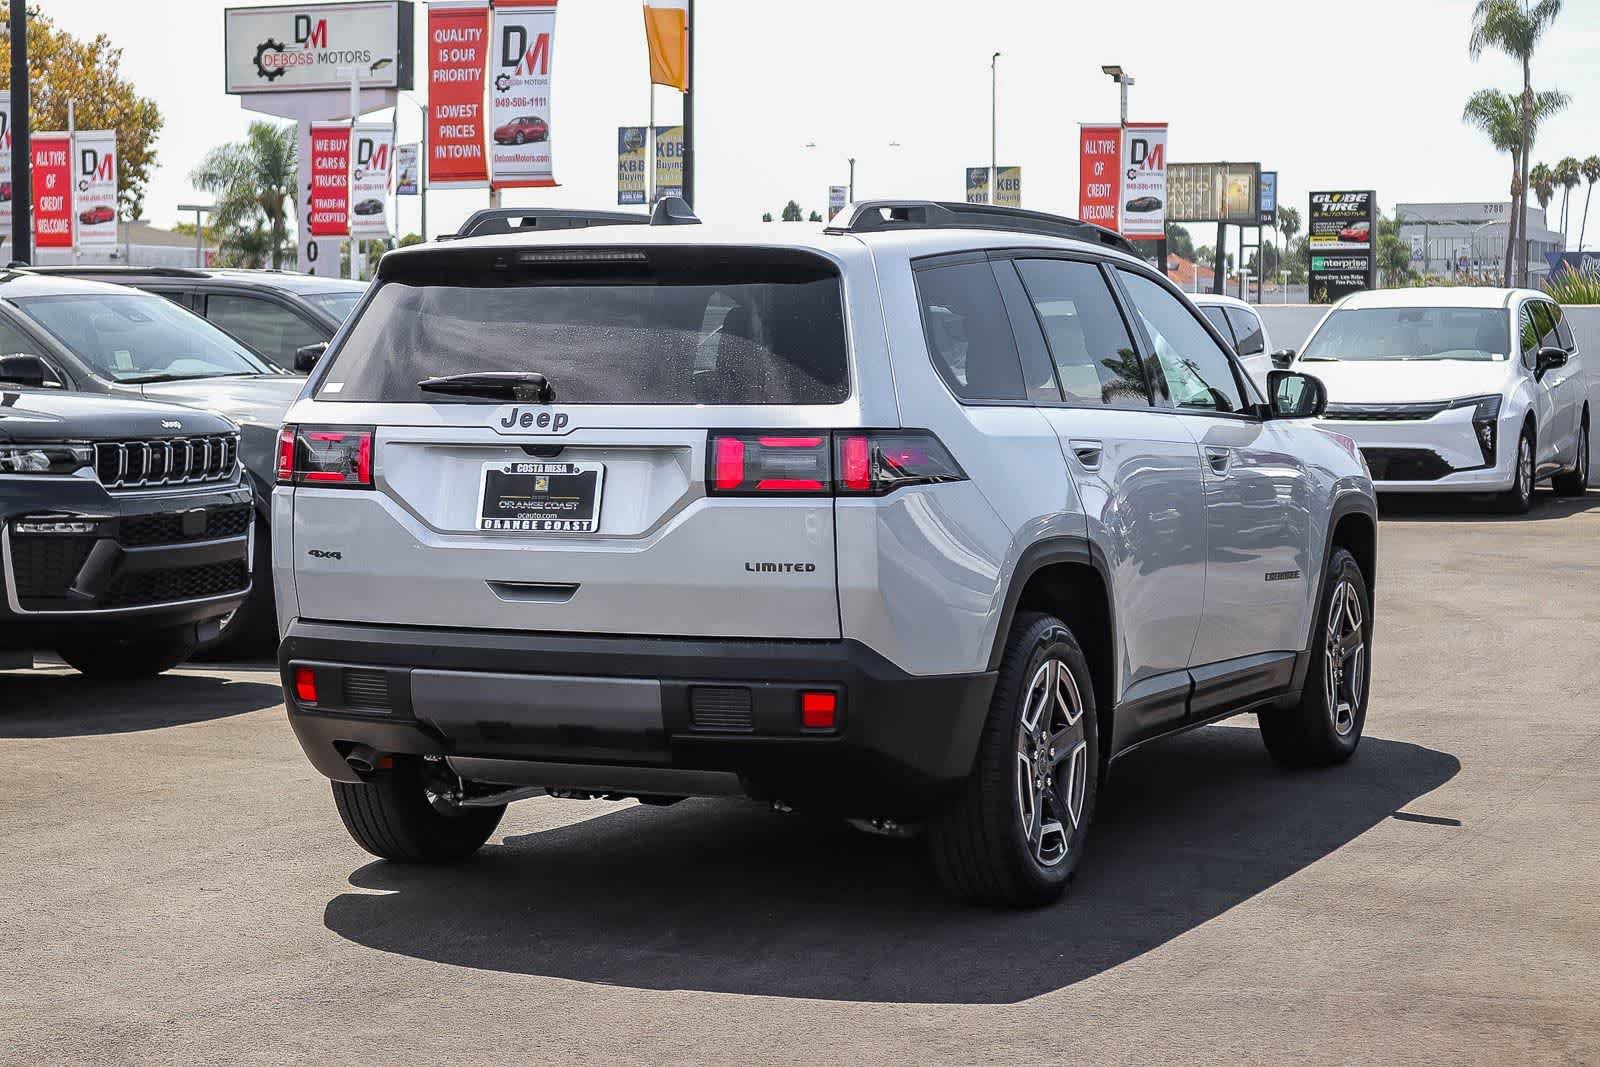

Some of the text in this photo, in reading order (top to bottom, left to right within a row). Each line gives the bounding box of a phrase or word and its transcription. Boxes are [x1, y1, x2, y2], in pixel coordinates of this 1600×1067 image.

[434, 28, 482, 44] QUALITY
[440, 48, 476, 62] IS OUR
[502, 25, 550, 76] DM
[264, 50, 370, 66] DEBOSS MOTORS
[434, 68, 482, 82] PRIORITY
[436, 104, 478, 118] LOWEST
[440, 124, 476, 138] PRICES
[315, 140, 348, 152] WE BUY
[435, 144, 481, 158] IN TOWN
[1085, 140, 1116, 154] ALL TYPE
[36, 151, 66, 166] ALL TYPE
[1131, 138, 1164, 170] DM
[316, 157, 346, 170] CARS &
[1094, 162, 1104, 176] OF
[46, 174, 56, 188] OF
[316, 175, 346, 187] TRUCKS
[1088, 184, 1112, 198] CREDIT
[40, 196, 64, 212] CREDIT
[315, 198, 346, 208] TRADE-IN
[1312, 194, 1368, 203] GLOBE
[1083, 204, 1114, 220] WELCOME
[1322, 203, 1360, 212] TIRE
[314, 212, 346, 222] ACCEPTED
[38, 218, 68, 234] WELCOME
[501, 408, 568, 432] Jeep
[517, 464, 567, 473] COSTA MESA
[499, 500, 580, 510] ORANGE COAST
[517, 512, 558, 520] ocauto.com
[484, 520, 590, 530] ORANGE COAST
[744, 562, 816, 572] LIMITED
